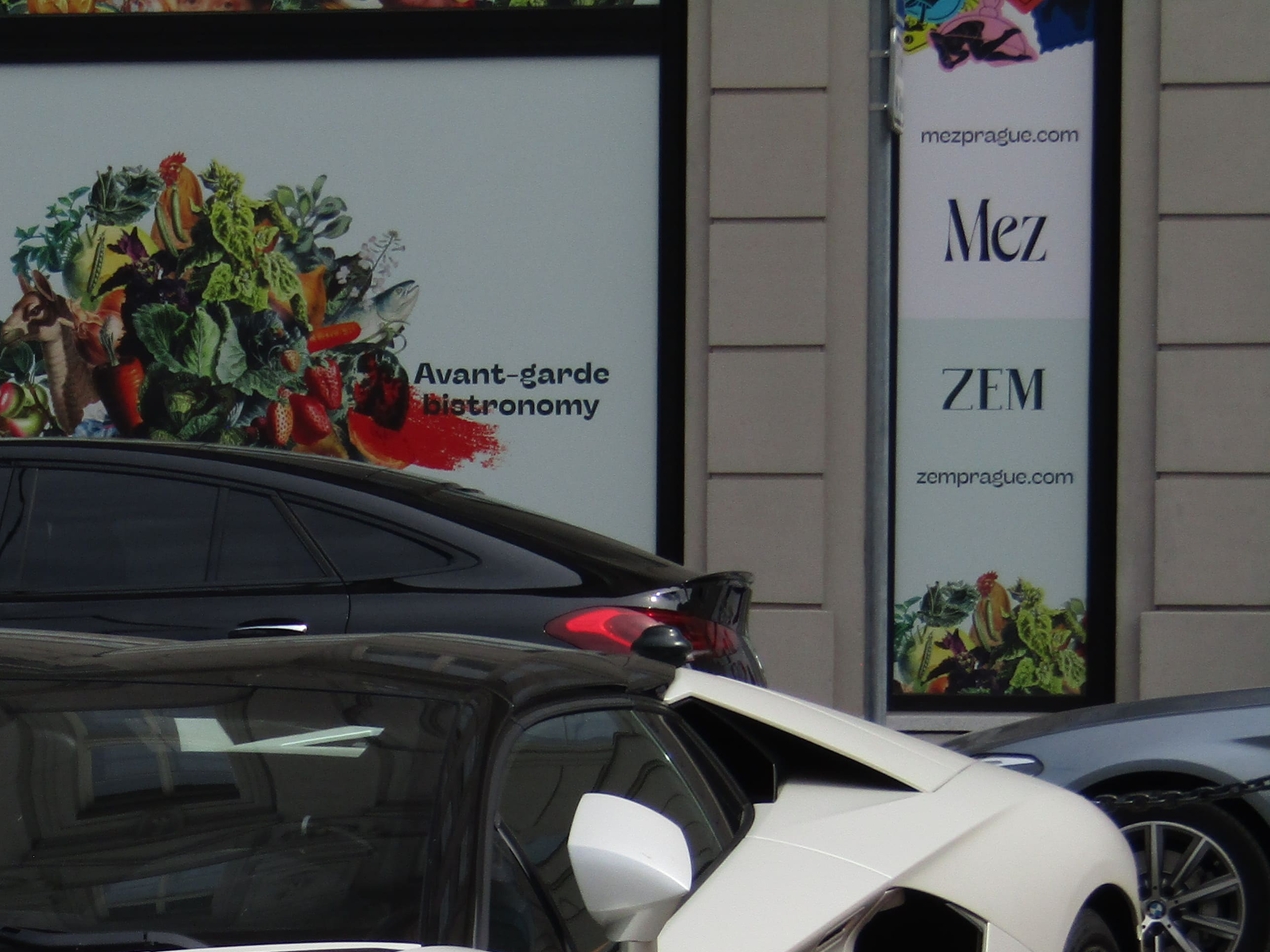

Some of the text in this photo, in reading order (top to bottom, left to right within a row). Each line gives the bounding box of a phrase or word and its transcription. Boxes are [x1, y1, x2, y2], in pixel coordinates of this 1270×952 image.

[920, 127, 1079, 147] mezprague.com
[944, 198, 1048, 263] Mez
[414, 362, 610, 389] Avant-garde
[942, 368, 1046, 411] ZEM
[423, 393, 600, 420] bistronomy
[916, 469, 1074, 488] zemprague.com
